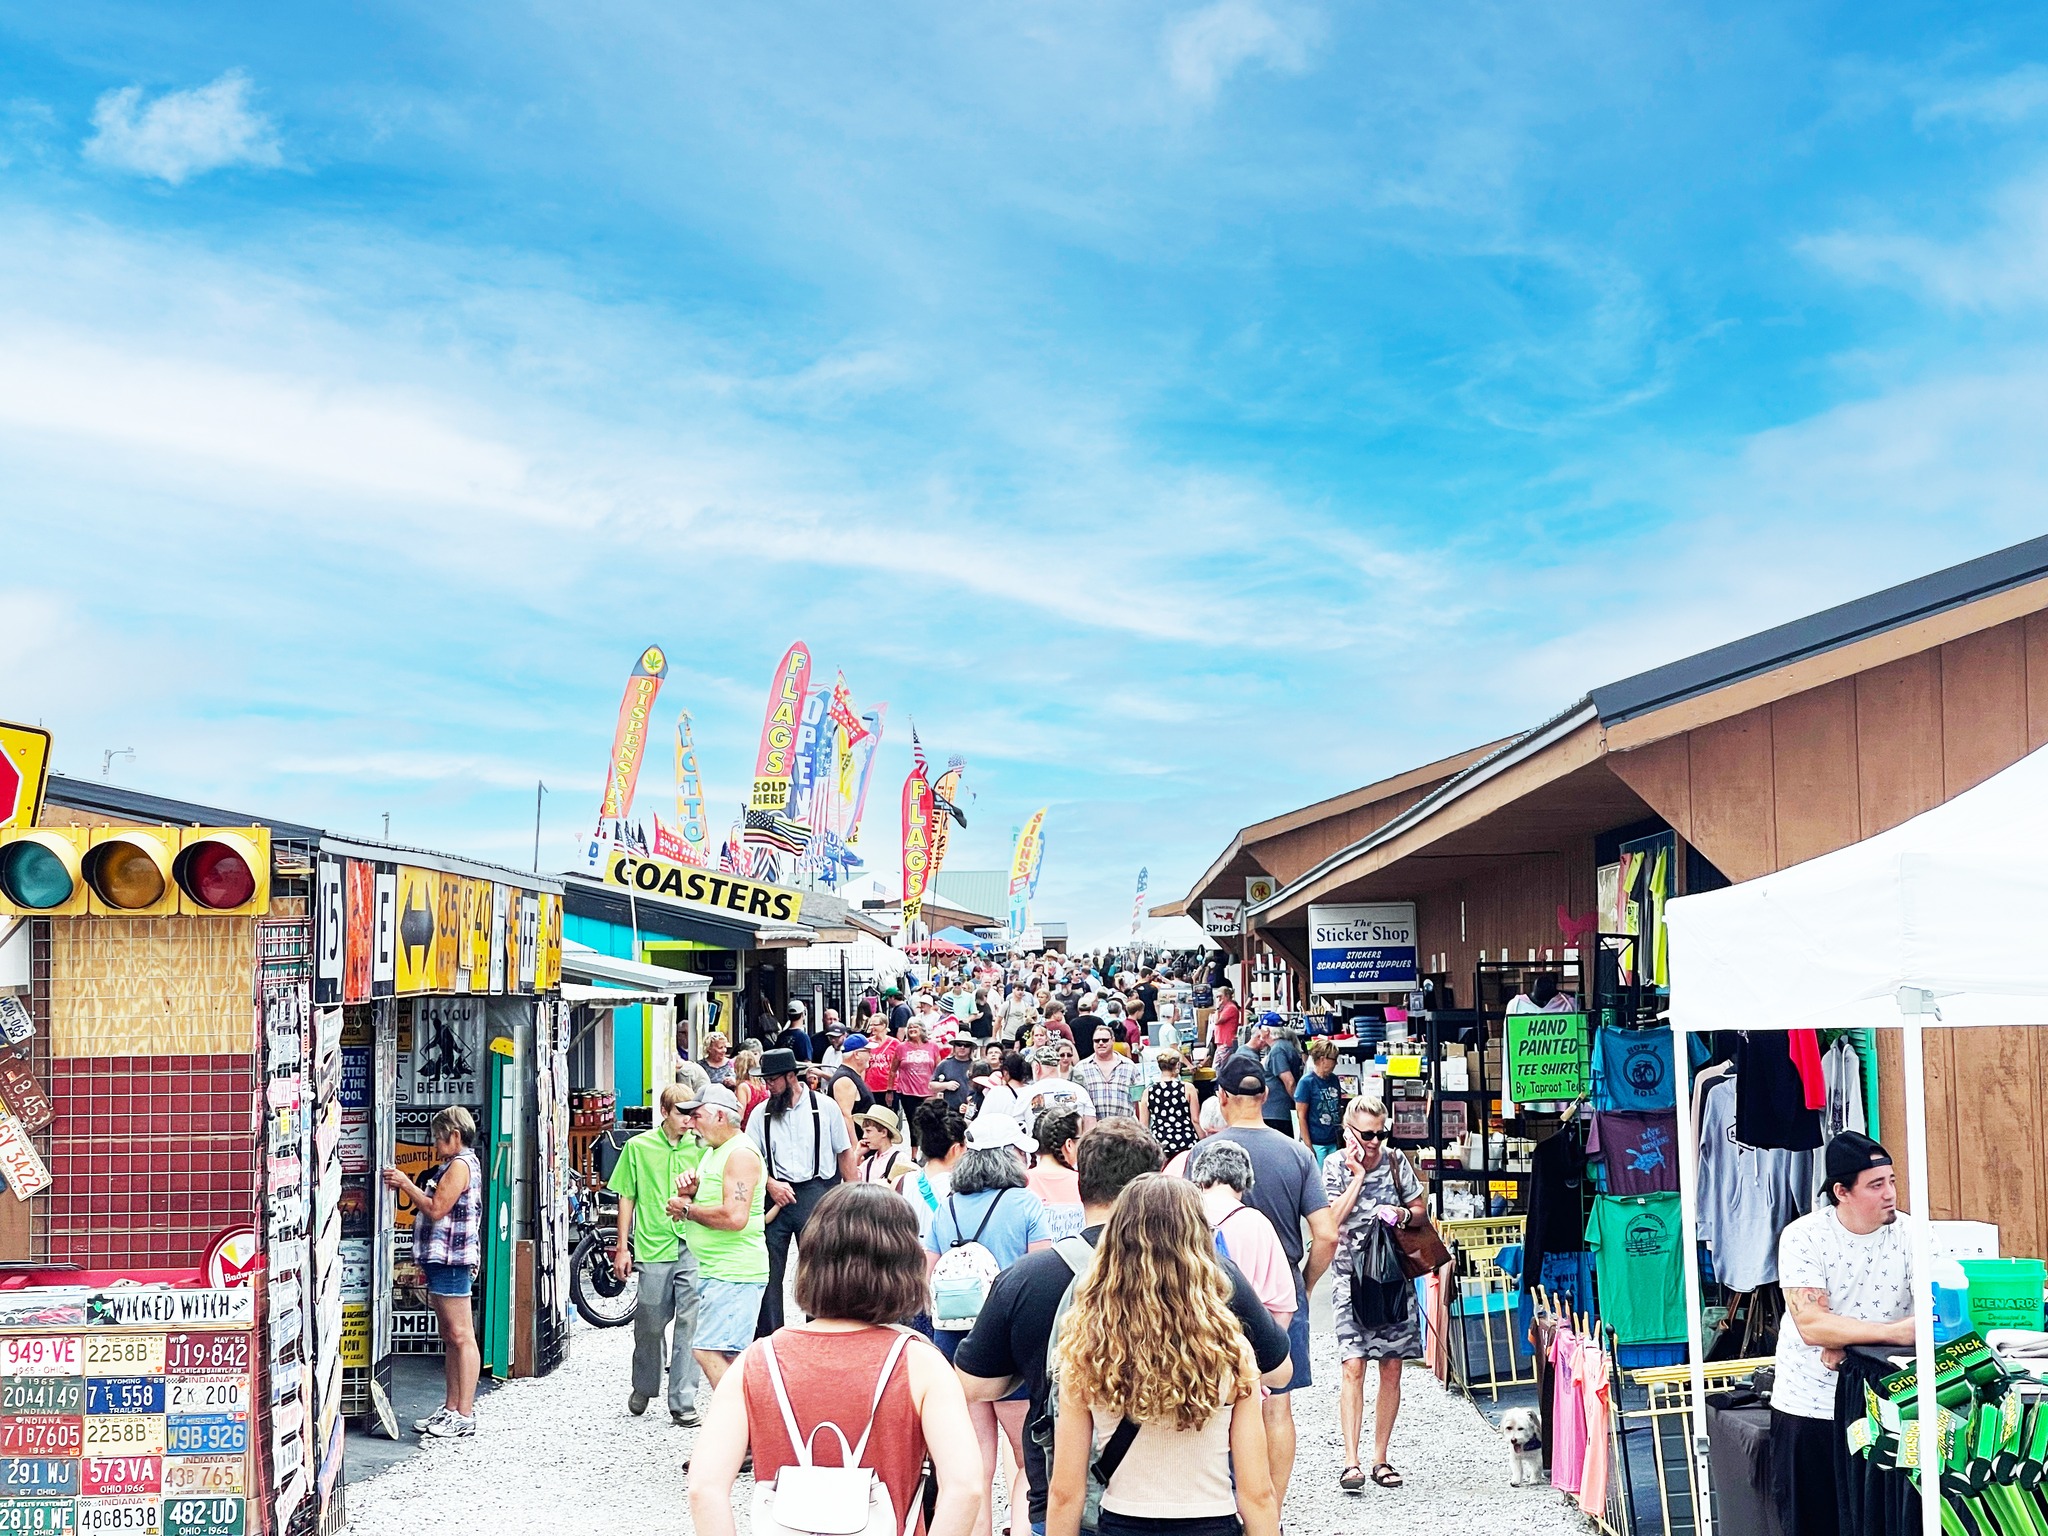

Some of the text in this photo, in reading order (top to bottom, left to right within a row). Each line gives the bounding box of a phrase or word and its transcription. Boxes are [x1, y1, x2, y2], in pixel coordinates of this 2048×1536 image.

[765, 652, 806, 774] FLAGS
[795, 695, 825, 816] OPEN
[753, 781, 787, 793] SOLD
[753, 793, 786, 805] HERE
[659, 838, 679, 852] SOLD
[906, 779, 928, 896] FLAGS
[1018, 813, 1043, 873] SIGNS
[613, 858, 793, 921] COASTERS
[441, 881, 458, 938] 35
[475, 890, 491, 942] 40
[323, 882, 339, 960] 15
[380, 892, 389, 963] E
[1206, 923, 1241, 932] SPICES
[1353, 919, 1373, 927] The
[1316, 926, 1409, 943] Sticker Shop
[1346, 951, 1382, 960] STICKERS
[1316, 960, 1412, 970] SCRAPBOOKING SUPPLIES
[1349, 970, 1380, 979] & GIFTS
[421, 1009, 471, 1021] DO YOU
[1527, 1018, 1568, 1037] HAND
[1518, 1037, 1578, 1056] PAINTED
[1626, 1043, 1650, 1054] HOW
[357, 1056, 367, 1064] IS
[341, 1067, 367, 1077] ETTER
[1517, 1062, 1580, 1076] TEE SHIRTS
[349, 1079, 366, 1088] THE
[417, 1082, 474, 1094] BELIEVE
[1515, 1080, 1586, 1097] By Taproot Tees
[338, 1091, 362, 1100] POOL
[1633, 1088, 1659, 1097] ROLL
[395, 1112, 433, 1123] GFOOT
[6, 1147, 41, 1193] 3422
[111, 1293, 230, 1321] WICKED WITCH
[231, 1297, 249, 1312] WAY
[1972, 1297, 2040, 1310] MENARDS
[88, 1344, 147, 1362] 2258B
[1945, 1338, 1984, 1357] Stick
[16, 1366, 65, 1375] 1965 OHIO
[3, 1386, 79, 1408] 20A4149
[122, 1385, 153, 1407] 558
[206, 1385, 238, 1405] 200
[22, 1417, 62, 1425] NDIANA
[4, 1426, 80, 1447] 71B7605
[87, 1424, 146, 1443] 2258B
[183, 1456, 225, 1464] INDIANA
[8, 1462, 70, 1484] 291 WJ
[165, 1466, 234, 1488] 43B 765
[36, 1488, 57, 1496] OHIO
[100, 1484, 145, 1494] OHIO 1966
[101, 1497, 143, 1506] INDIANA
[0, 1508, 74, 1530] 2818 WE
[82, 1507, 156, 1530] 48G8538
[179, 1526, 229, 1535] OHIO 1964
